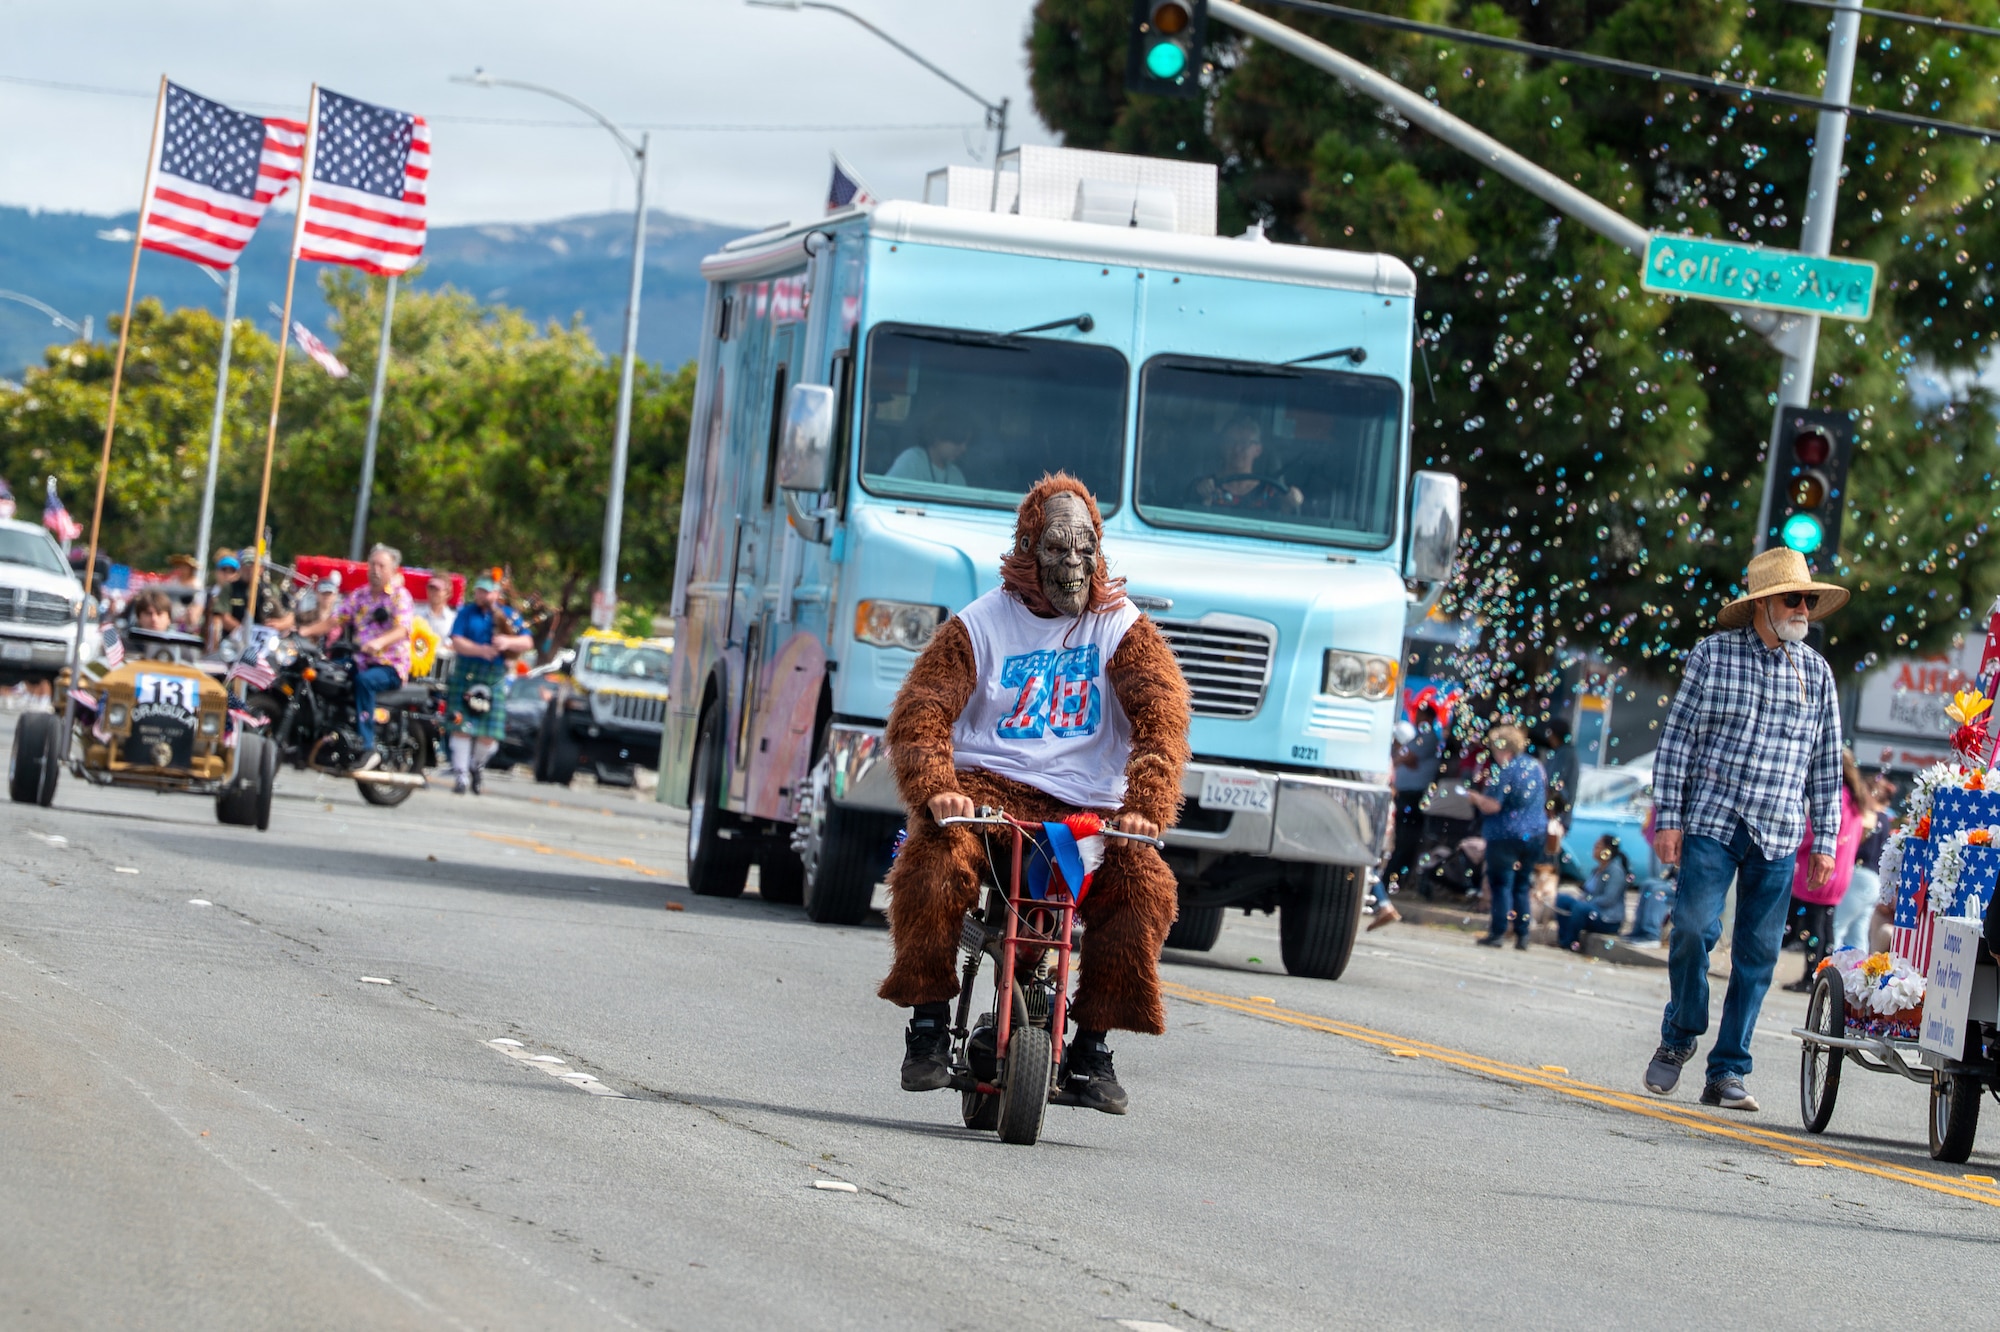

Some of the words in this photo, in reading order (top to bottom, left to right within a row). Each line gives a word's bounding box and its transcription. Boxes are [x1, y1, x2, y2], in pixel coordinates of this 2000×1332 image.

[1654, 245, 1781, 295] College
[1800, 269, 1862, 302] Ave
[149, 681, 183, 706] 13
[997, 643, 1100, 739] 76
[131, 703, 199, 732] DRAGULA
[1291, 745, 1318, 760] 0221
[1205, 784, 1268, 809] 1492742
[1944, 927, 1962, 958] Lompoc
[1935, 960, 1949, 988] Food
[1946, 963, 1962, 997] Pantry
